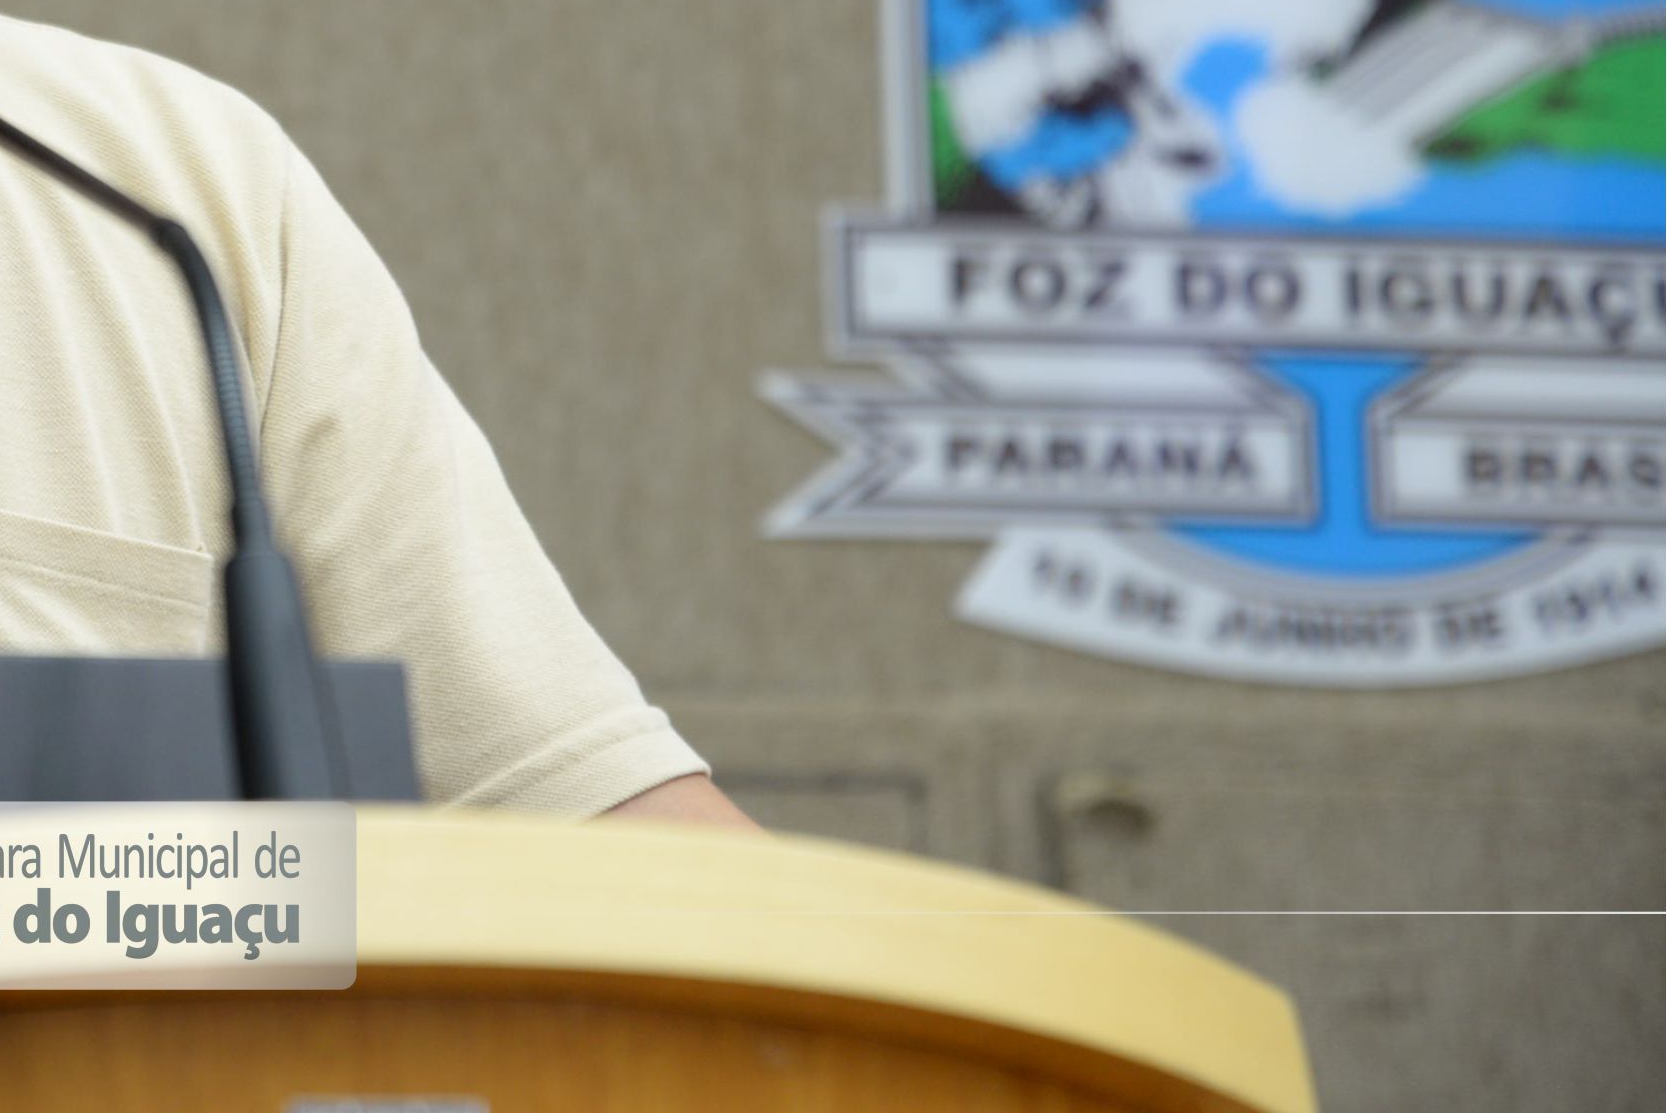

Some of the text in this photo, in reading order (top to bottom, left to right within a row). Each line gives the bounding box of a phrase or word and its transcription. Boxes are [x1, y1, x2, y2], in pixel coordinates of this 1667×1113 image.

[950, 254, 1130, 312] FOZ
[1174, 258, 1302, 318] DO
[944, 426, 1256, 484] PARANÁ
